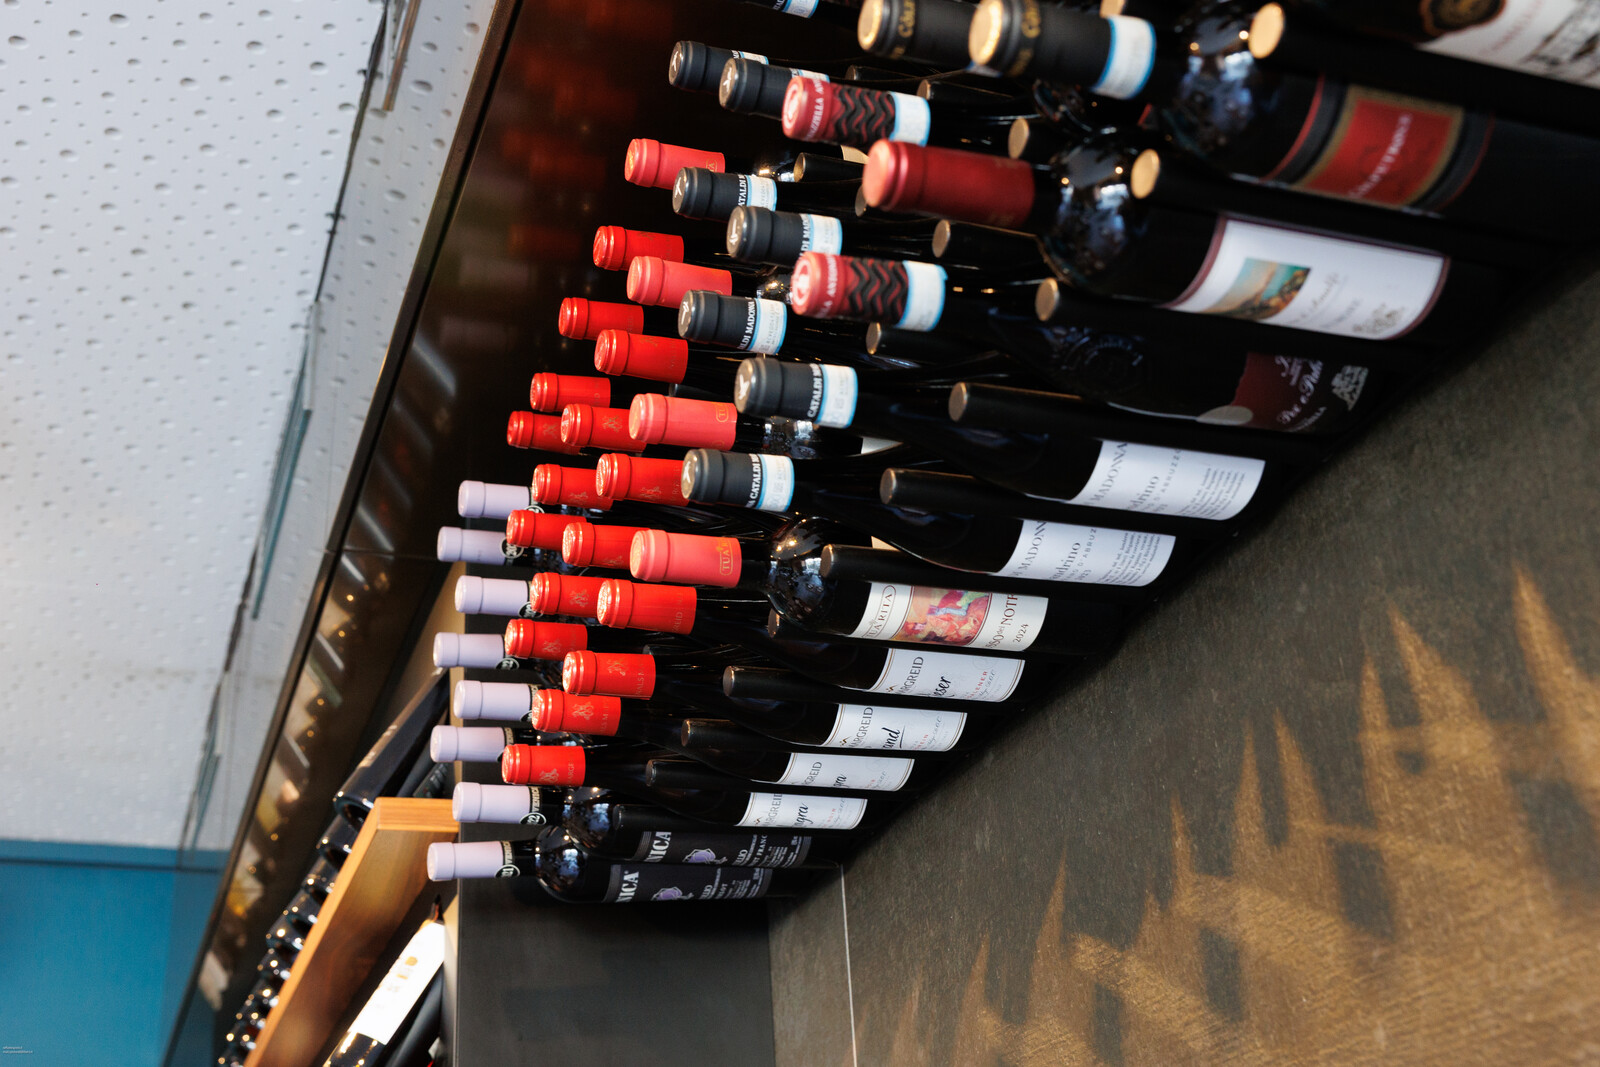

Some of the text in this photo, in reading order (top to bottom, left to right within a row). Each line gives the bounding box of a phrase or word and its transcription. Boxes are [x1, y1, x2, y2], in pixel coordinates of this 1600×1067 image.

[807, 377, 822, 418] CATALDI
[750, 463, 761, 499] CATALDI
[878, 593, 893, 621] RITA
[1012, 623, 1029, 643] 2024
